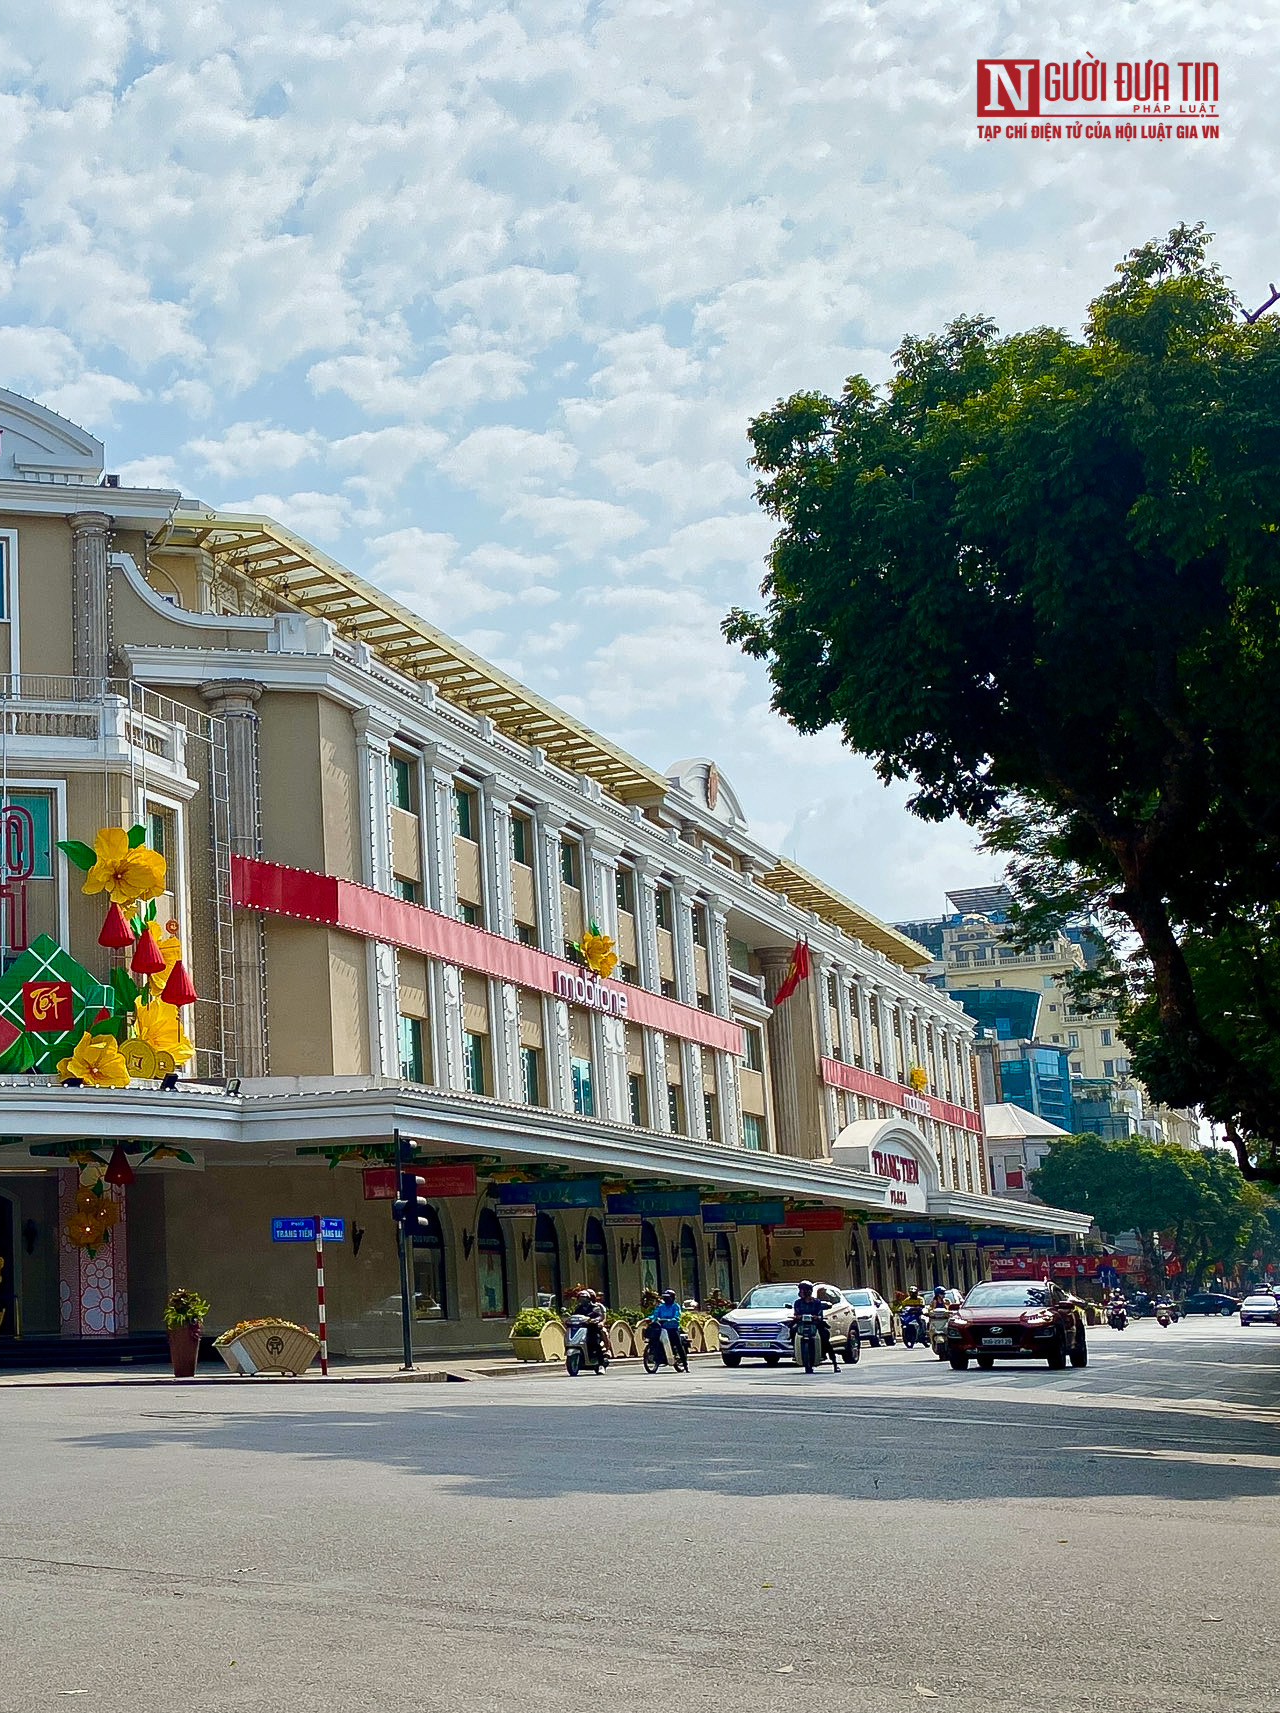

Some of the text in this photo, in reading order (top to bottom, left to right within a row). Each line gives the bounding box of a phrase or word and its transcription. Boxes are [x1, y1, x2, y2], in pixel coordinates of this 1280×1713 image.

[871, 1150, 919, 1185] TRANG TIEN
[782, 1259, 815, 1267] ROLEX
